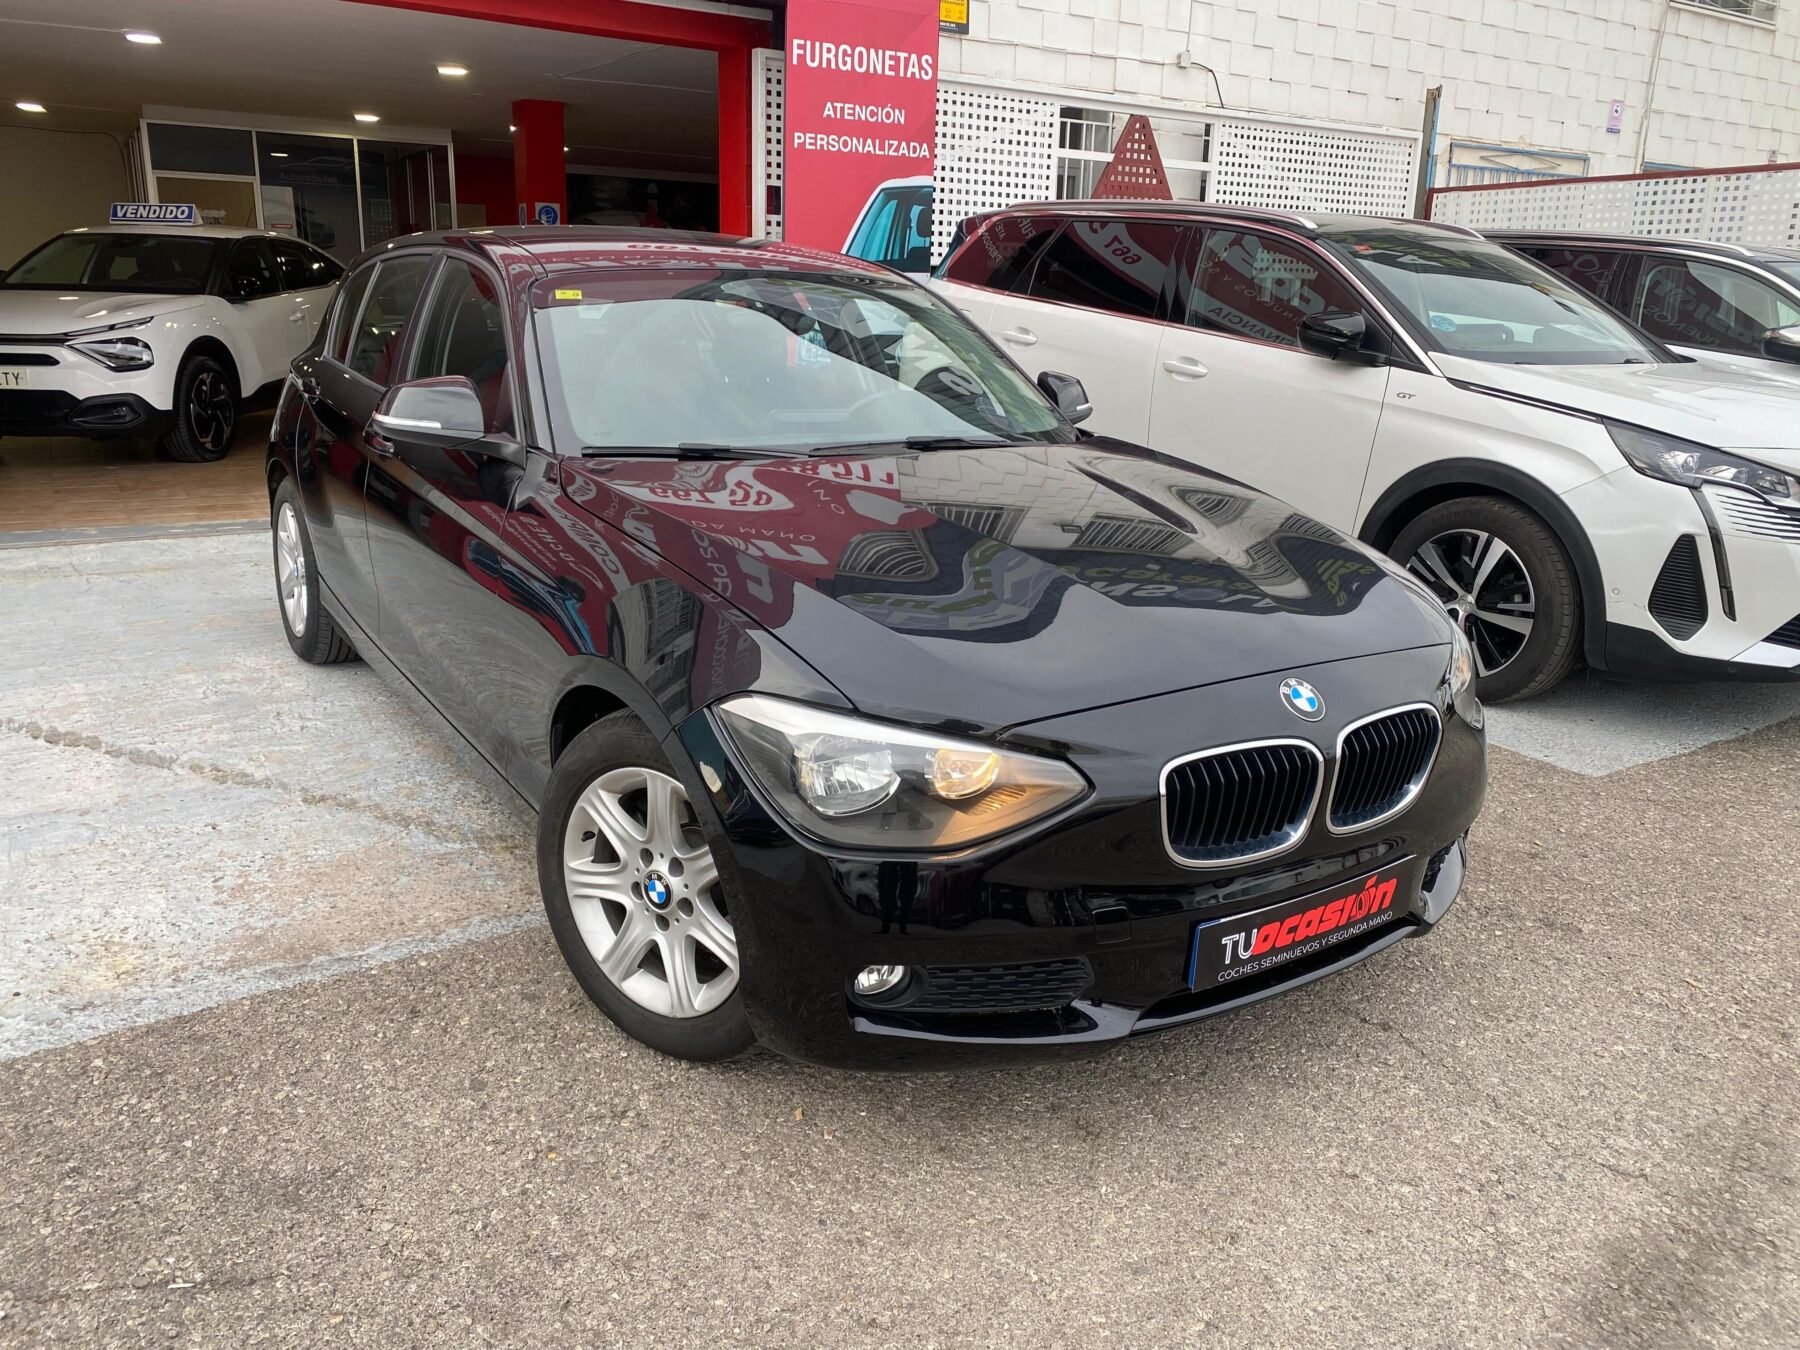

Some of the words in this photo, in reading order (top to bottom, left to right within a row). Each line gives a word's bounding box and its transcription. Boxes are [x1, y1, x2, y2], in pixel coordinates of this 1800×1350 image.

[792, 38, 933, 80] FURGONETAS
[823, 101, 906, 125] ATENCIÓN
[793, 132, 930, 159] PERSONALIZADA
[116, 205, 189, 219] VENDIDO
[0, 371, 20, 386] TY
[1217, 961, 1259, 982] COCHES
[1260, 941, 1320, 969] SEMINUEVOS
[1321, 937, 1329, 947] Y
[1328, 922, 1368, 945] SEGUNDA
[1368, 911, 1393, 929] MANO
